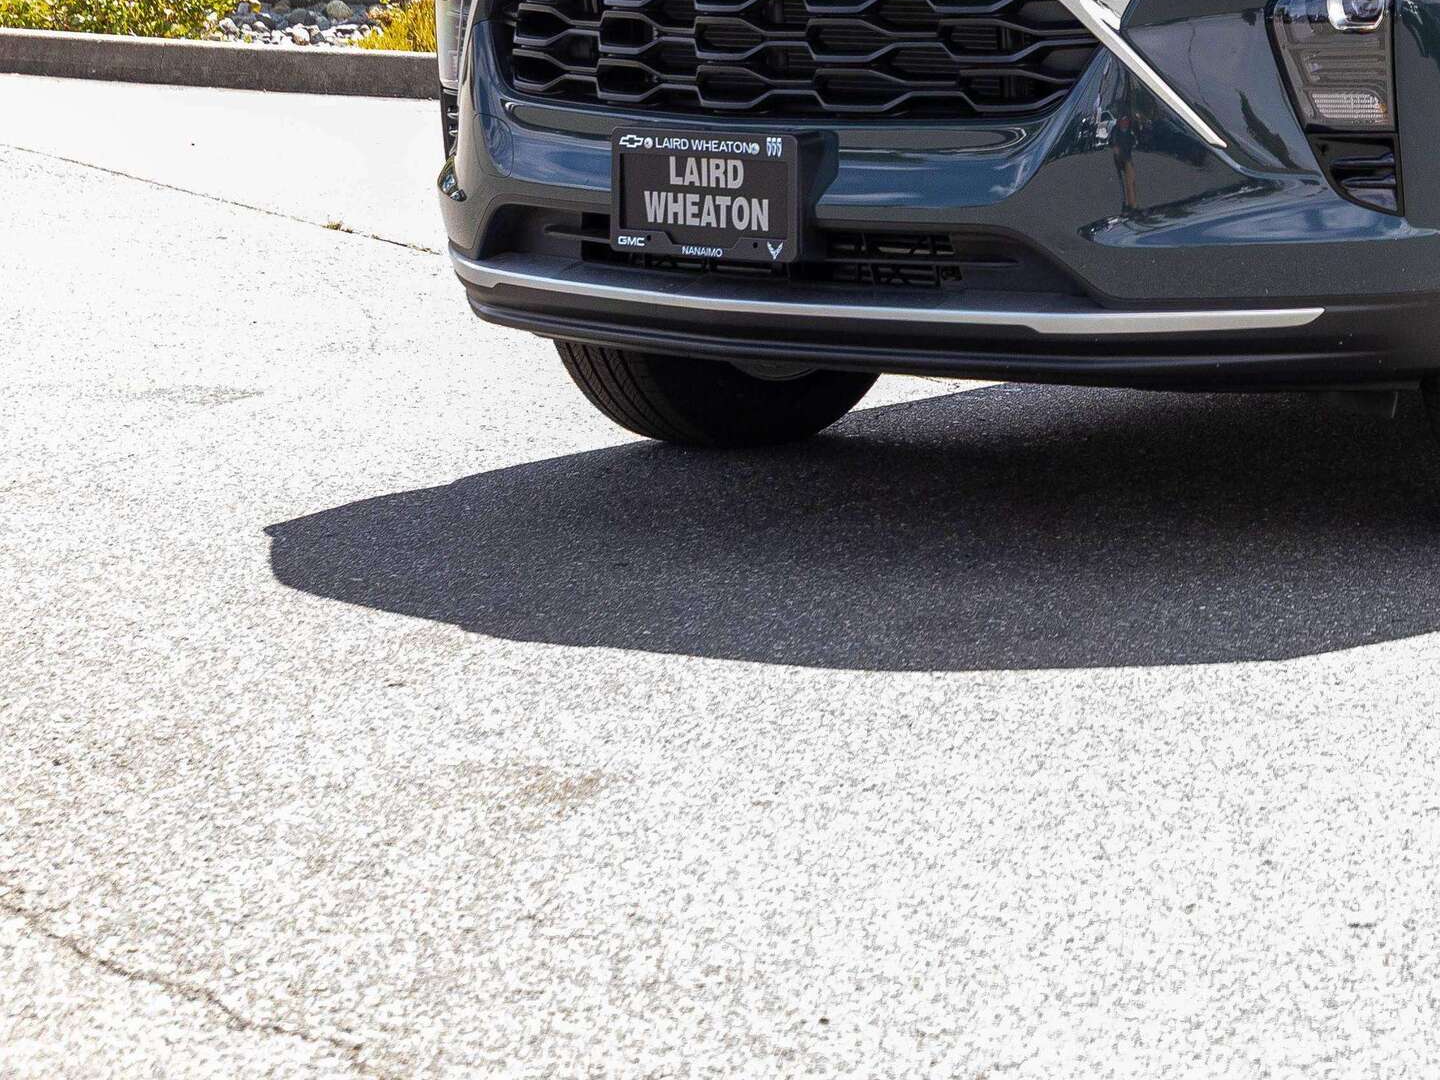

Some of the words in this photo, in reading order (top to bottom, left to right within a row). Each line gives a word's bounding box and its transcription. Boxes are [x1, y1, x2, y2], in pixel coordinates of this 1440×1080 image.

[655, 137, 689, 151] LAIRD
[692, 139, 752, 154] WHEATON
[669, 156, 744, 189] LAIRD
[643, 191, 769, 231] WHEATON
[618, 235, 645, 247] GMC
[681, 246, 723, 258] NANAIMO
